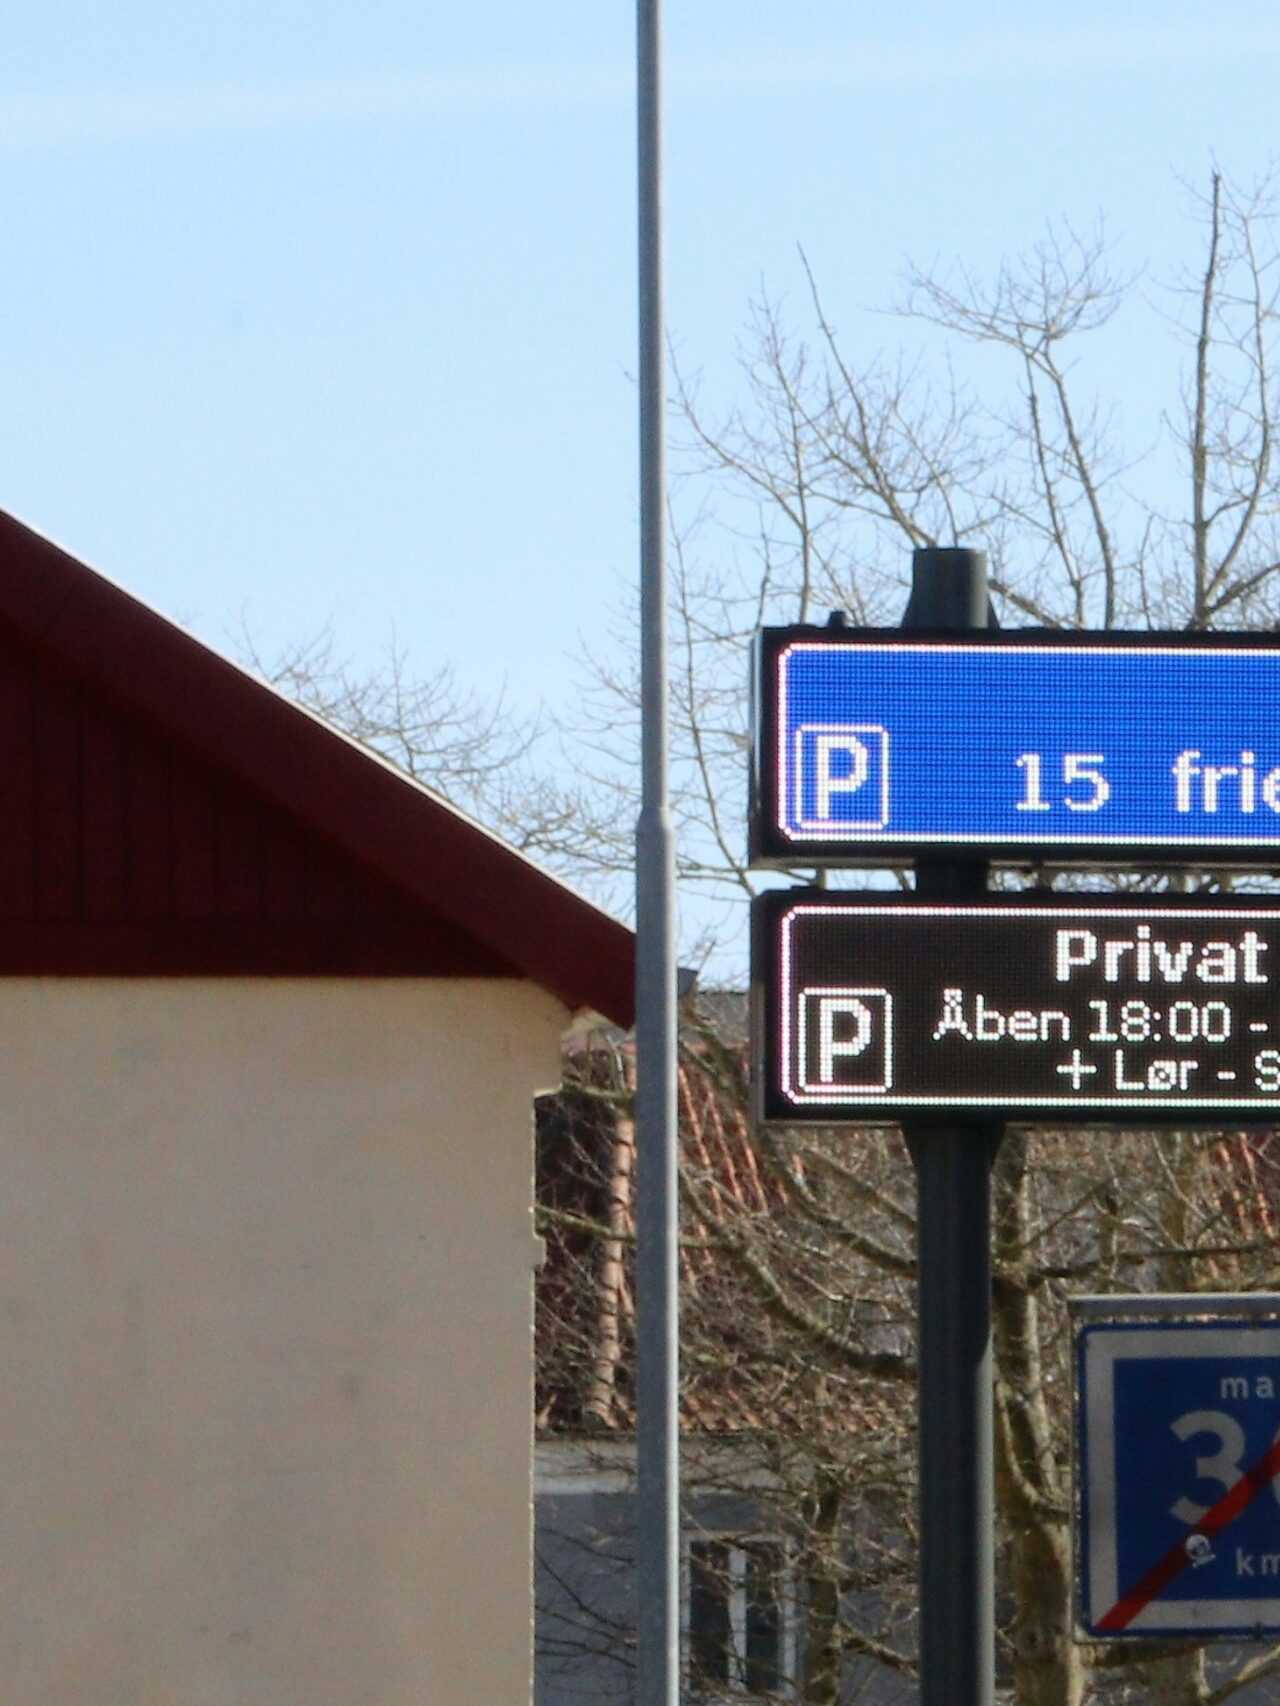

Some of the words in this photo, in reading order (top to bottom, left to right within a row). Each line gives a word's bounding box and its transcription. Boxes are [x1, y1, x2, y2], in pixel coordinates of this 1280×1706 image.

[1015, 753, 1112, 812] 15
[1055, 925, 1269, 984] Privat
[932, 988, 1071, 1042] Åben
[1088, 1000, 1232, 1043] 18:00
[1249, 1022, 1269, 1034] -
[1056, 1048, 1098, 1091] +
[1115, 1048, 1199, 1091] Lør
[1216, 1070, 1237, 1081] -
